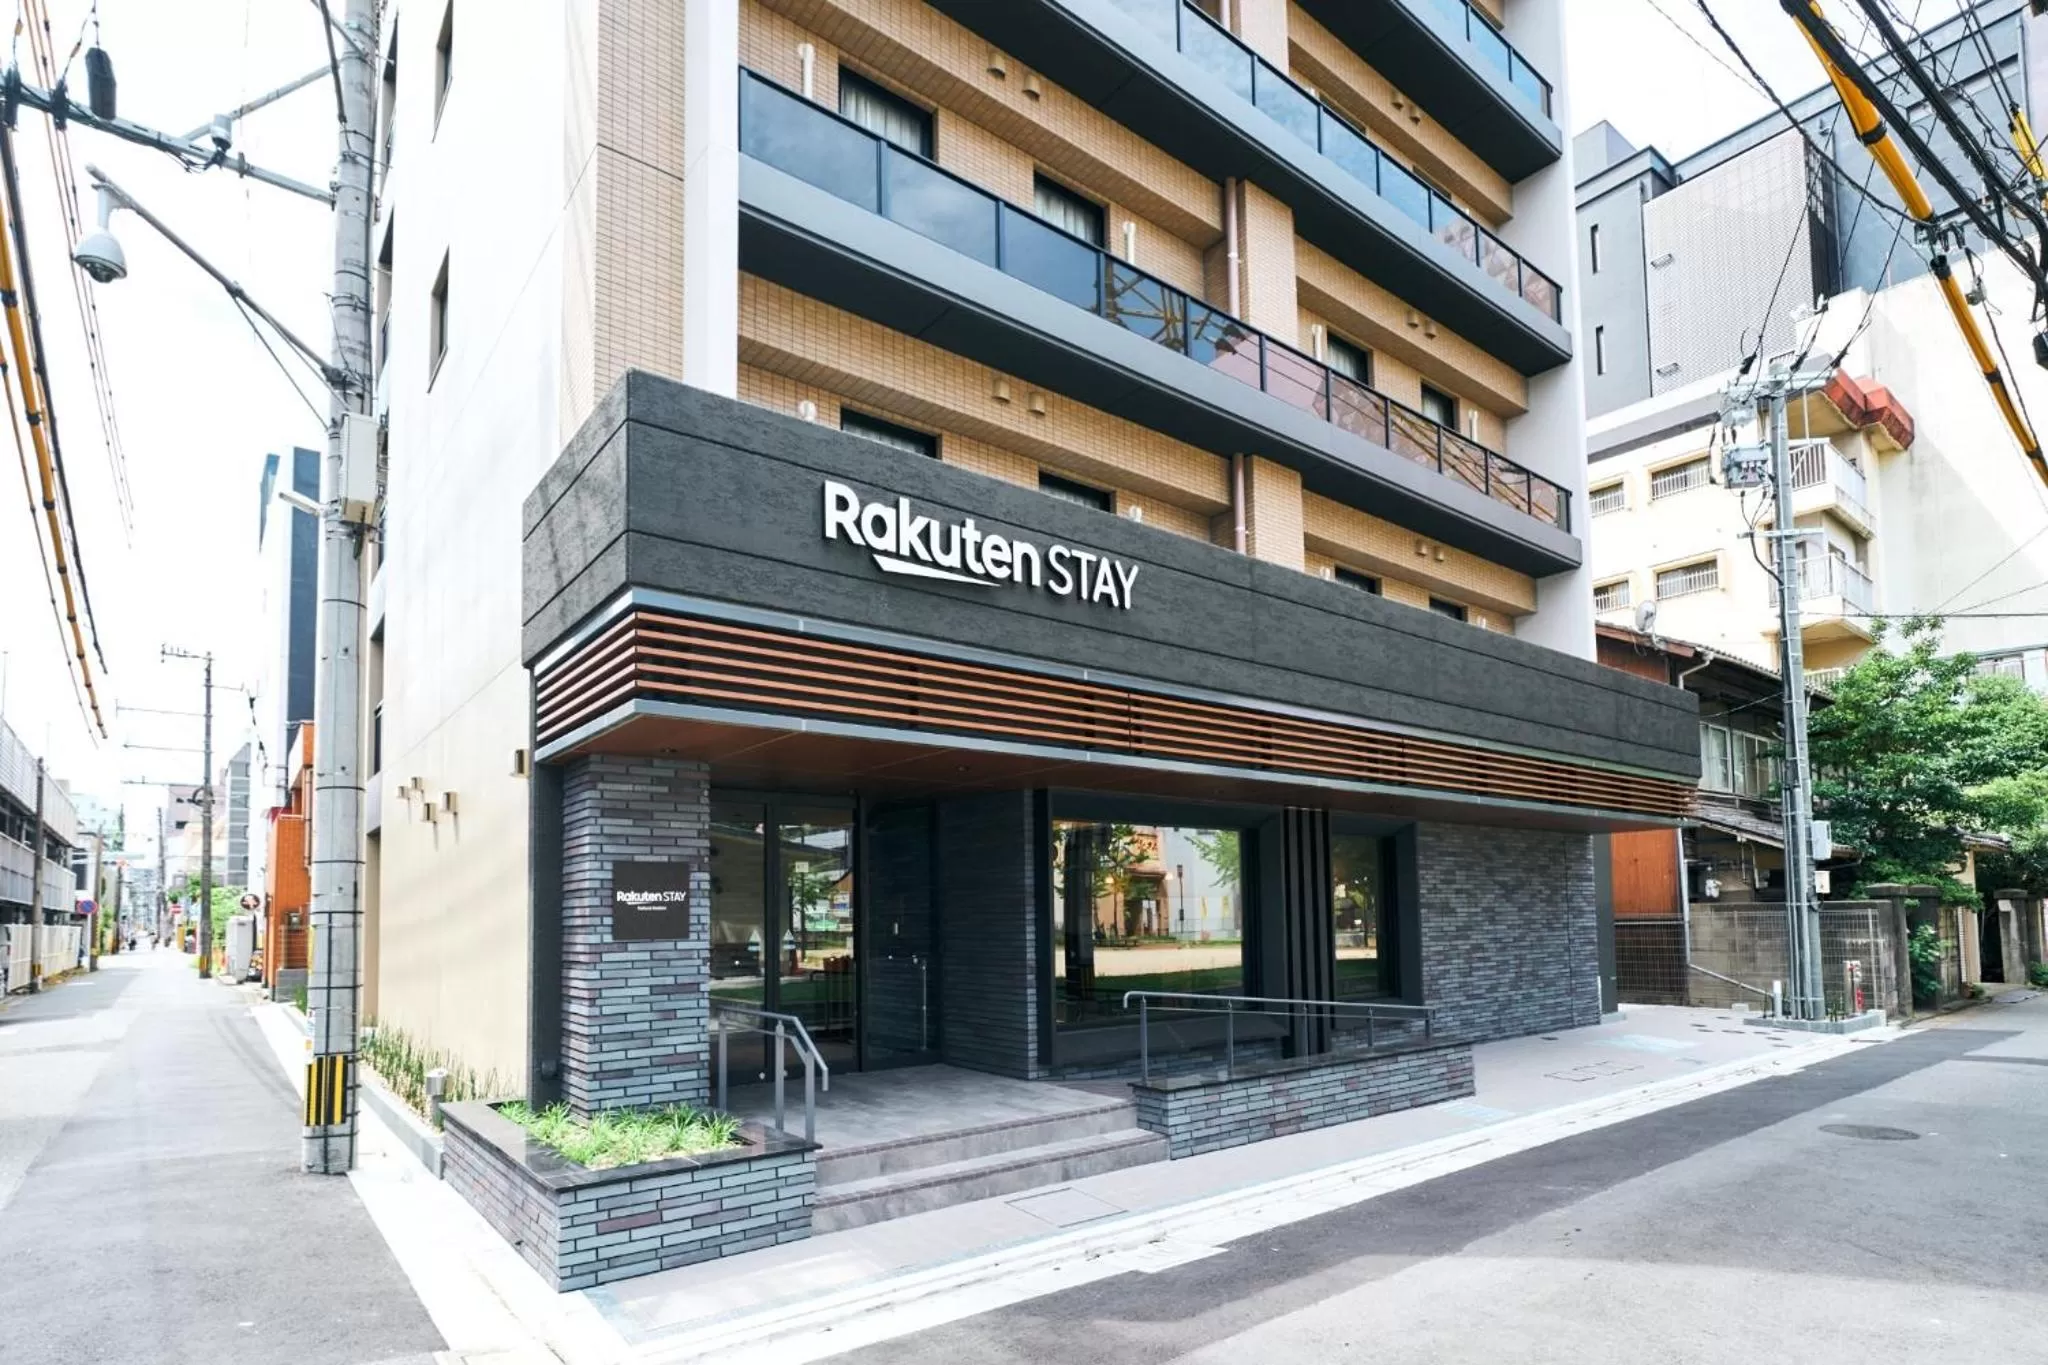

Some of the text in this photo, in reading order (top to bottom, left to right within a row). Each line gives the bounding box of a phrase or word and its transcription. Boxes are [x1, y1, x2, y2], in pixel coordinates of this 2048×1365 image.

[824, 479, 1139, 610] Rakuten STAY
[616, 890, 686, 904] Rakuten STAY
